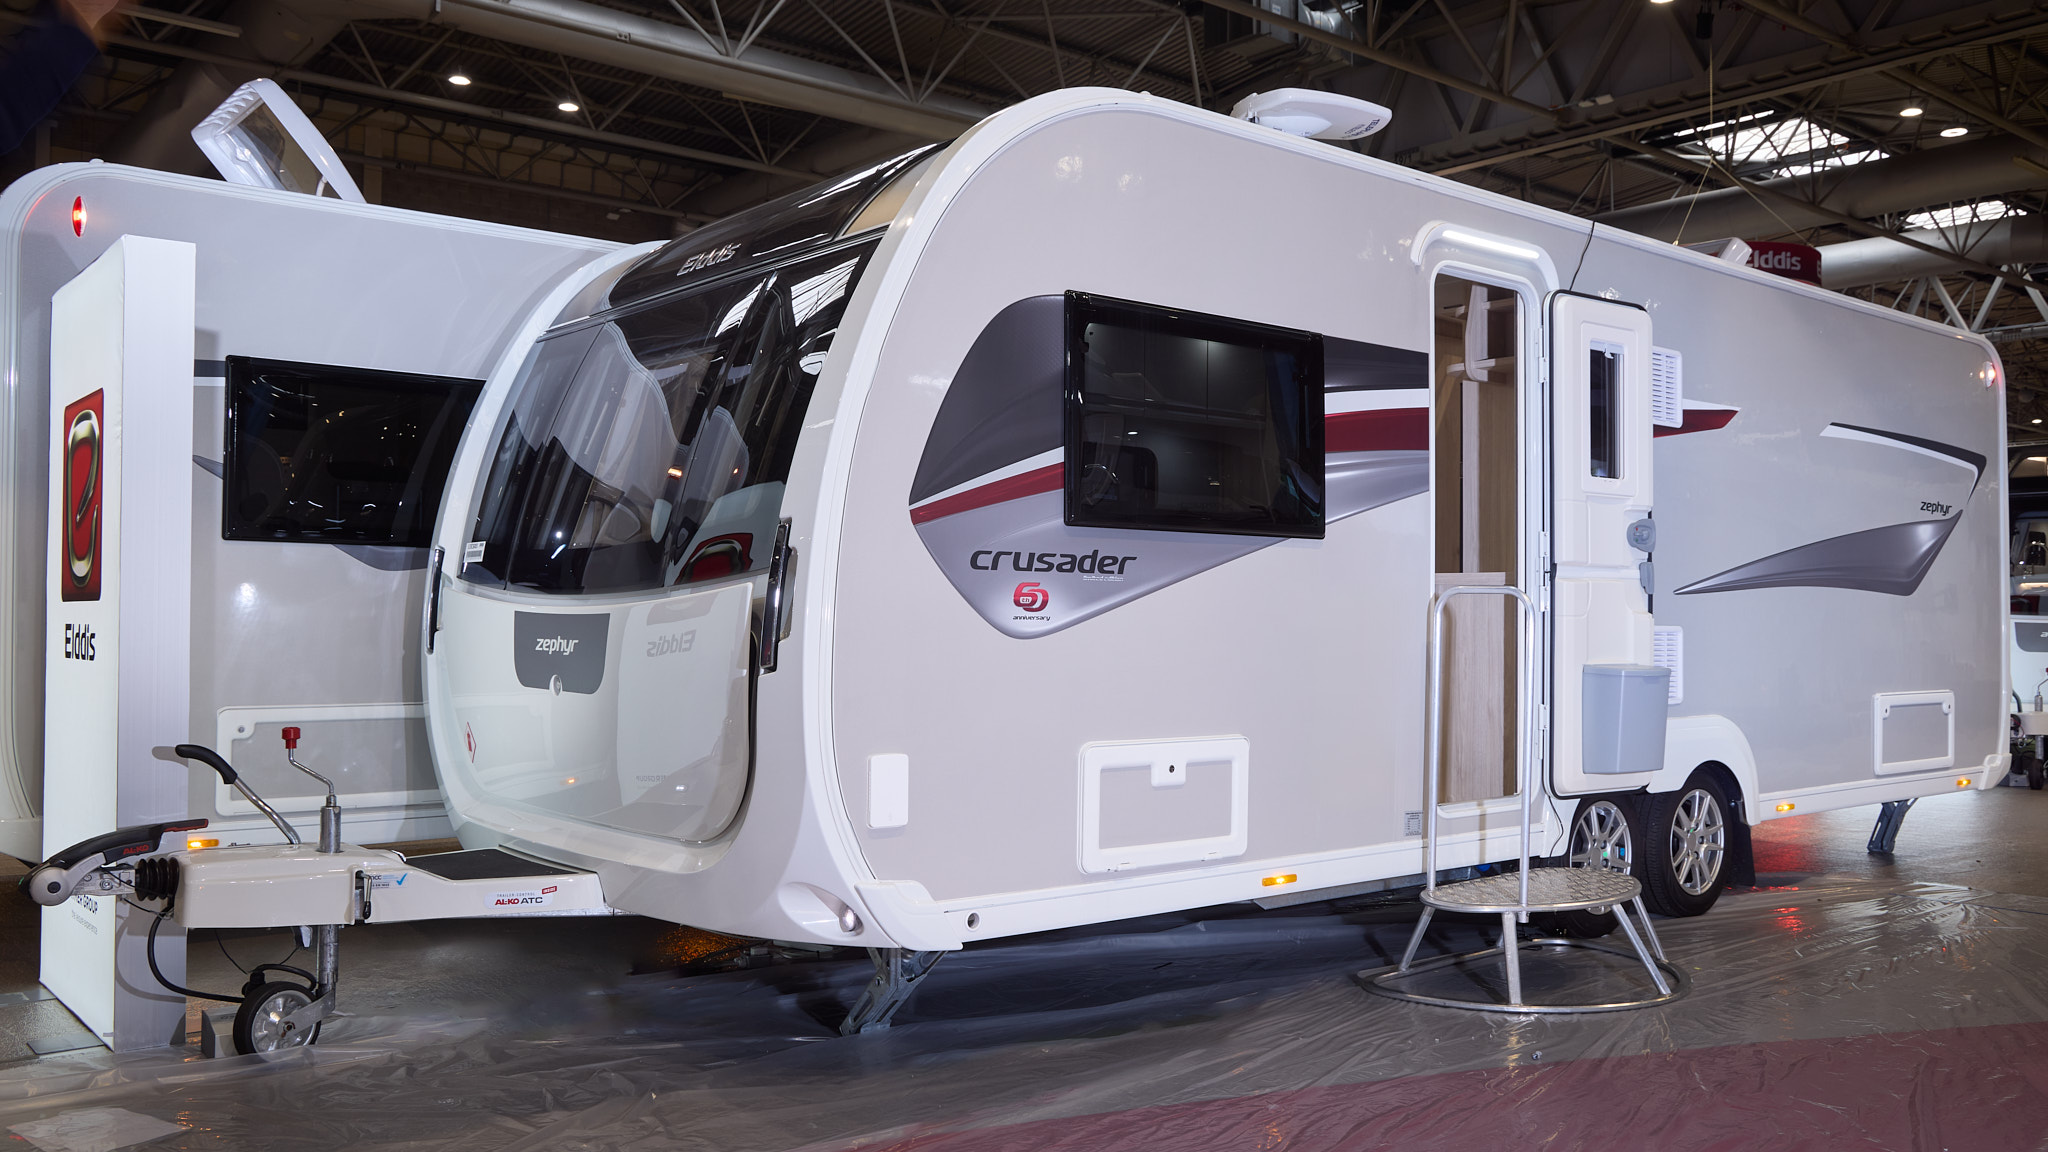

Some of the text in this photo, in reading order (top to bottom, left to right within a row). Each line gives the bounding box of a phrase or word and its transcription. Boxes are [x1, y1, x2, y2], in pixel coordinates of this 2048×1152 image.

[677, 243, 741, 276] Elddis
[1920, 501, 1952, 516] zephyr
[969, 549, 1138, 575] crusader
[65, 623, 96, 661] Elddis
[535, 636, 579, 655] zephyr
[520, 897, 543, 905] ATC
